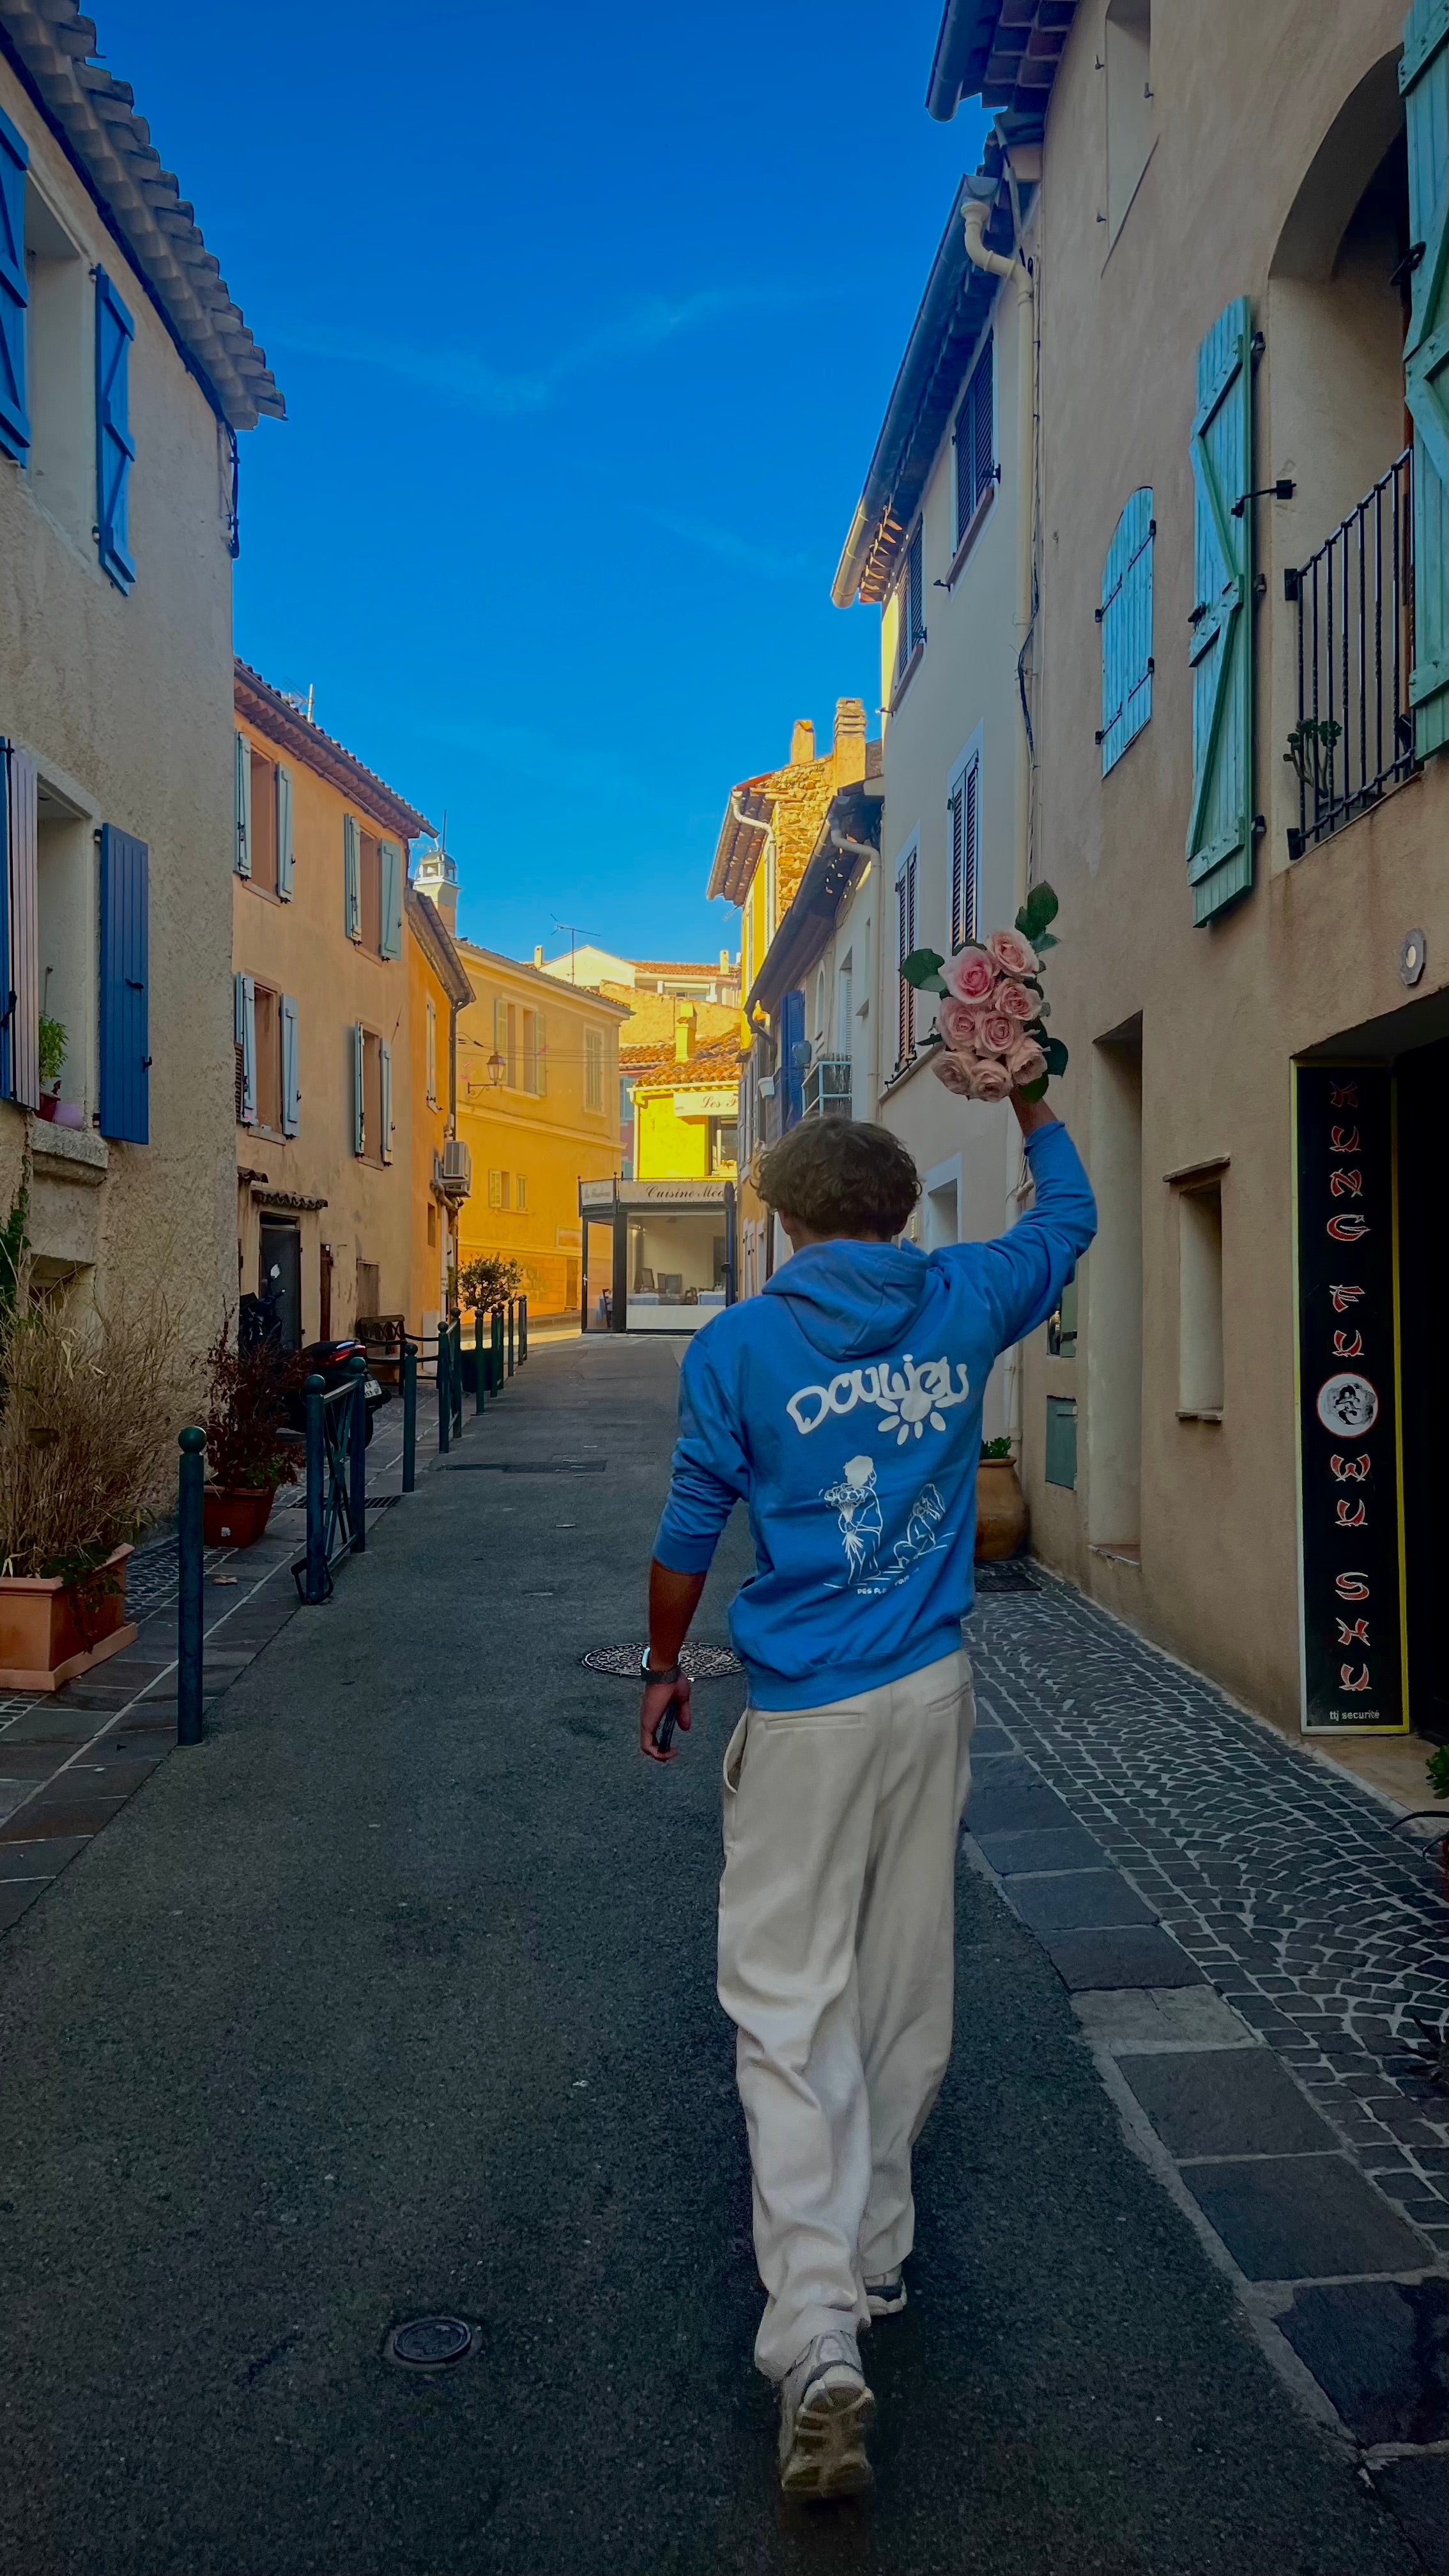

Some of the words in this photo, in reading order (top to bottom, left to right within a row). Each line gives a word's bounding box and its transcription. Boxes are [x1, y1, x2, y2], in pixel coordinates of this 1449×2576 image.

[646, 1184, 694, 1199] Cuisine
[1326, 1080, 1371, 1241] KUNG
[1329, 1284, 1365, 1358] FU
[1330, 1453, 1371, 1527] WU
[1335, 1571, 1373, 1692] SHU
